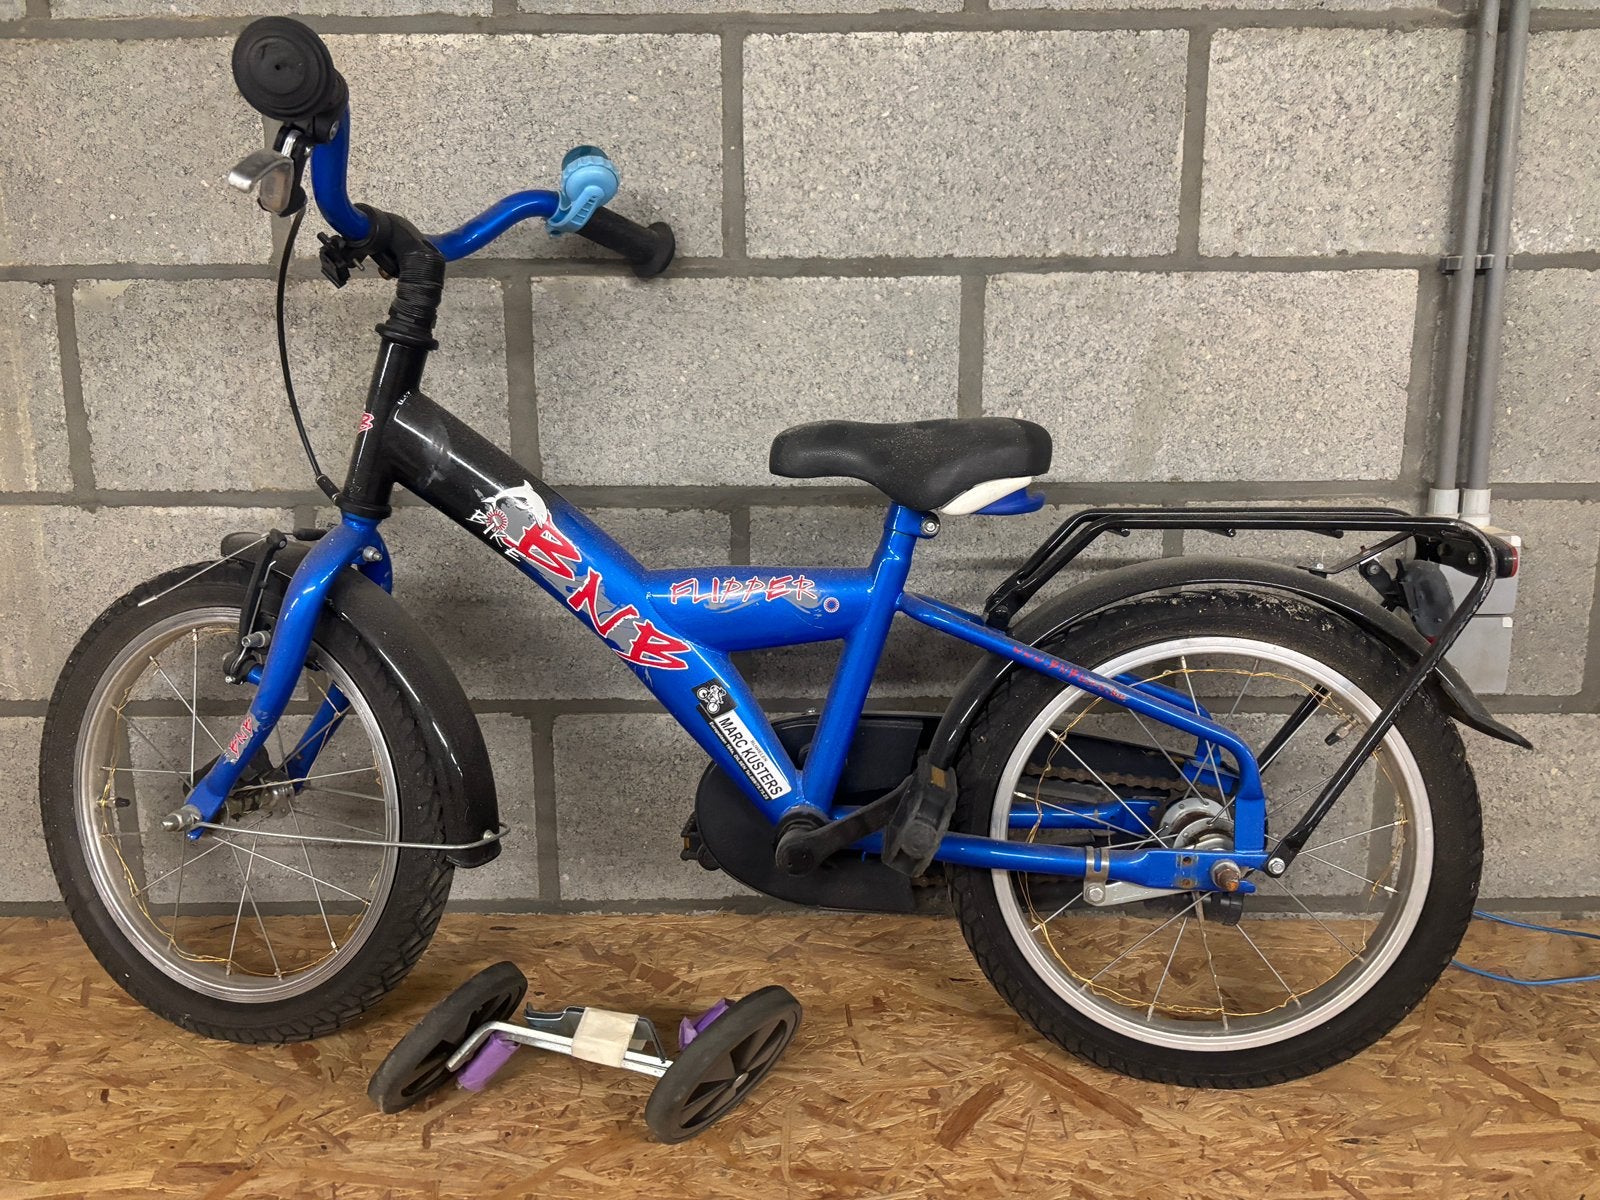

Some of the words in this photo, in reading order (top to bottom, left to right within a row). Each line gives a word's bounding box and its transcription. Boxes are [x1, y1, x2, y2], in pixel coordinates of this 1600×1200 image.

[465, 509, 527, 562] BIKE
[500, 509, 692, 671] BNB
[669, 574, 819, 605] FLIPPER
[718, 717, 748, 749] MARC
[741, 747, 783, 796] KUSTERS
